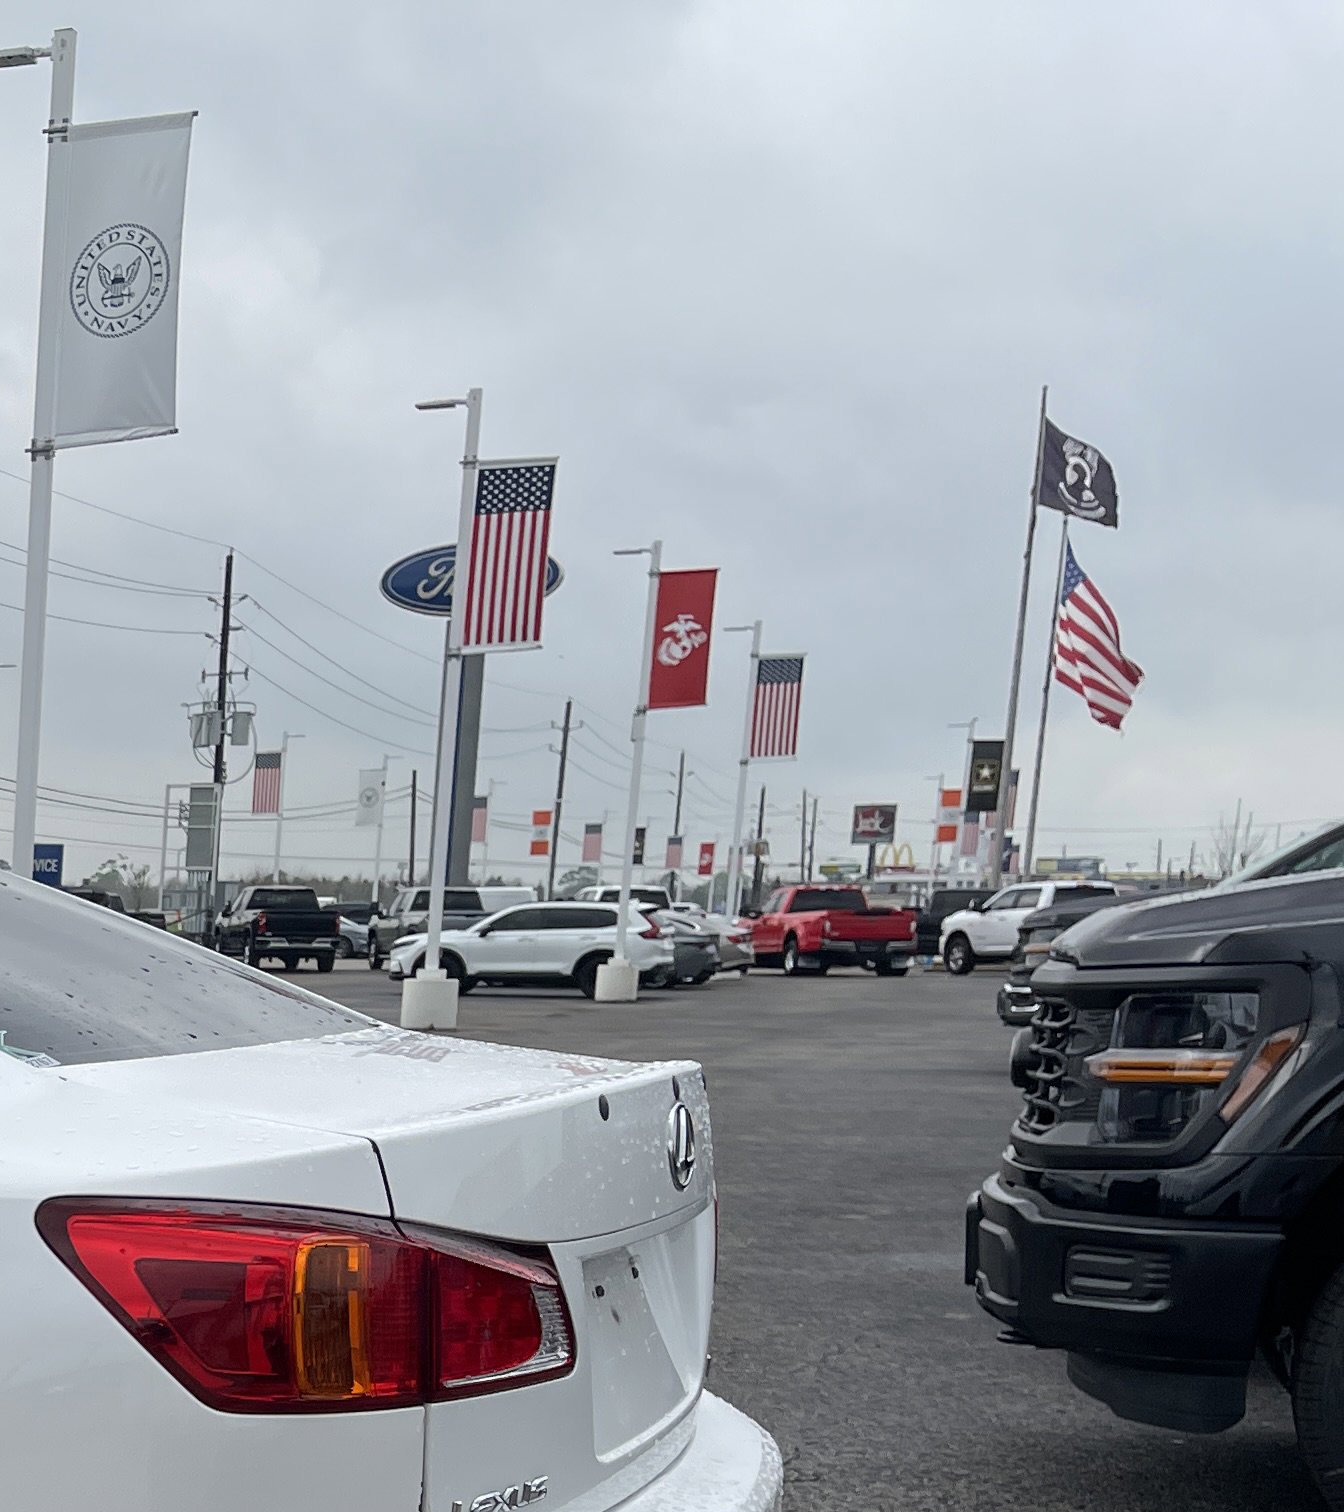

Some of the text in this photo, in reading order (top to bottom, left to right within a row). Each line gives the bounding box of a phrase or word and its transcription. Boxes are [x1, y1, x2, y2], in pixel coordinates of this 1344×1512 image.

[75, 229, 163, 307] UNITED STATES
[90, 308, 142, 332] NAVY
[33, 858, 59, 873] VICE
